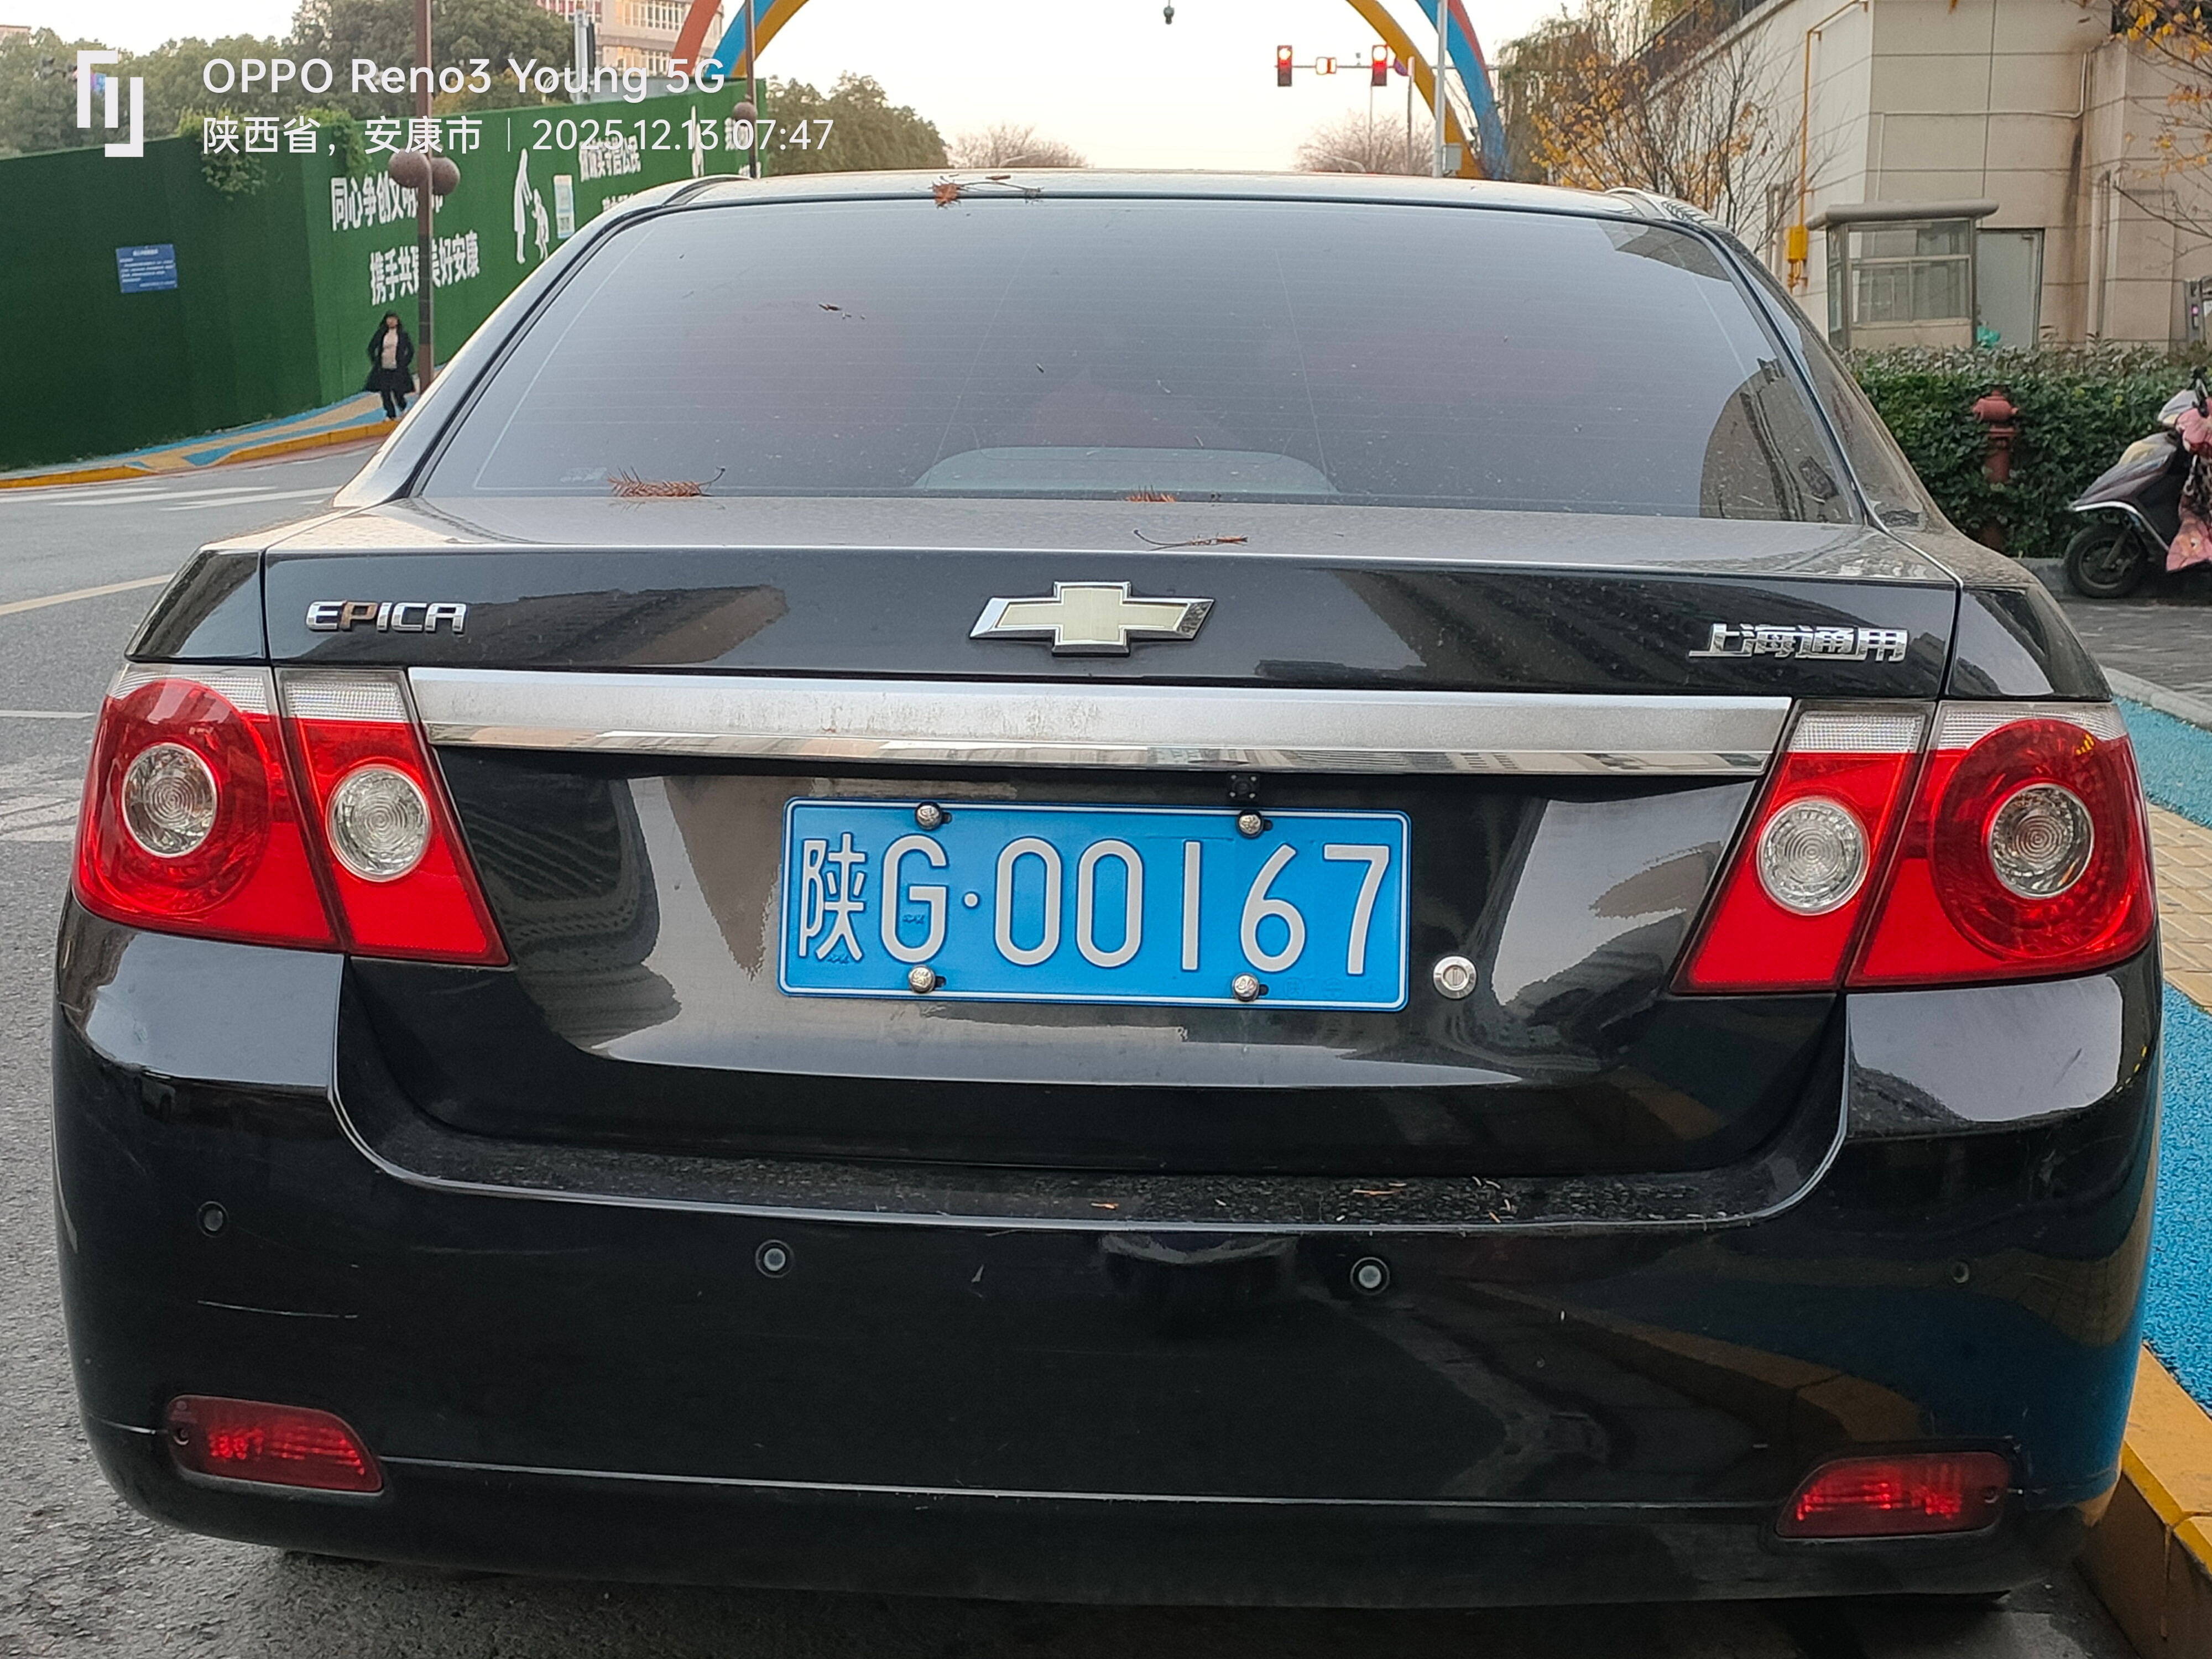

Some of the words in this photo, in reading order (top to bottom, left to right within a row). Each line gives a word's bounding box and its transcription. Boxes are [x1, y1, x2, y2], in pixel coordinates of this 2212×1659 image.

[331, 170, 444, 232] 同心争创文明
[306, 601, 467, 633] EPICA
[1688, 623, 1909, 662] 上海通用
[799, 833, 1390, 975] 陕G·00167
